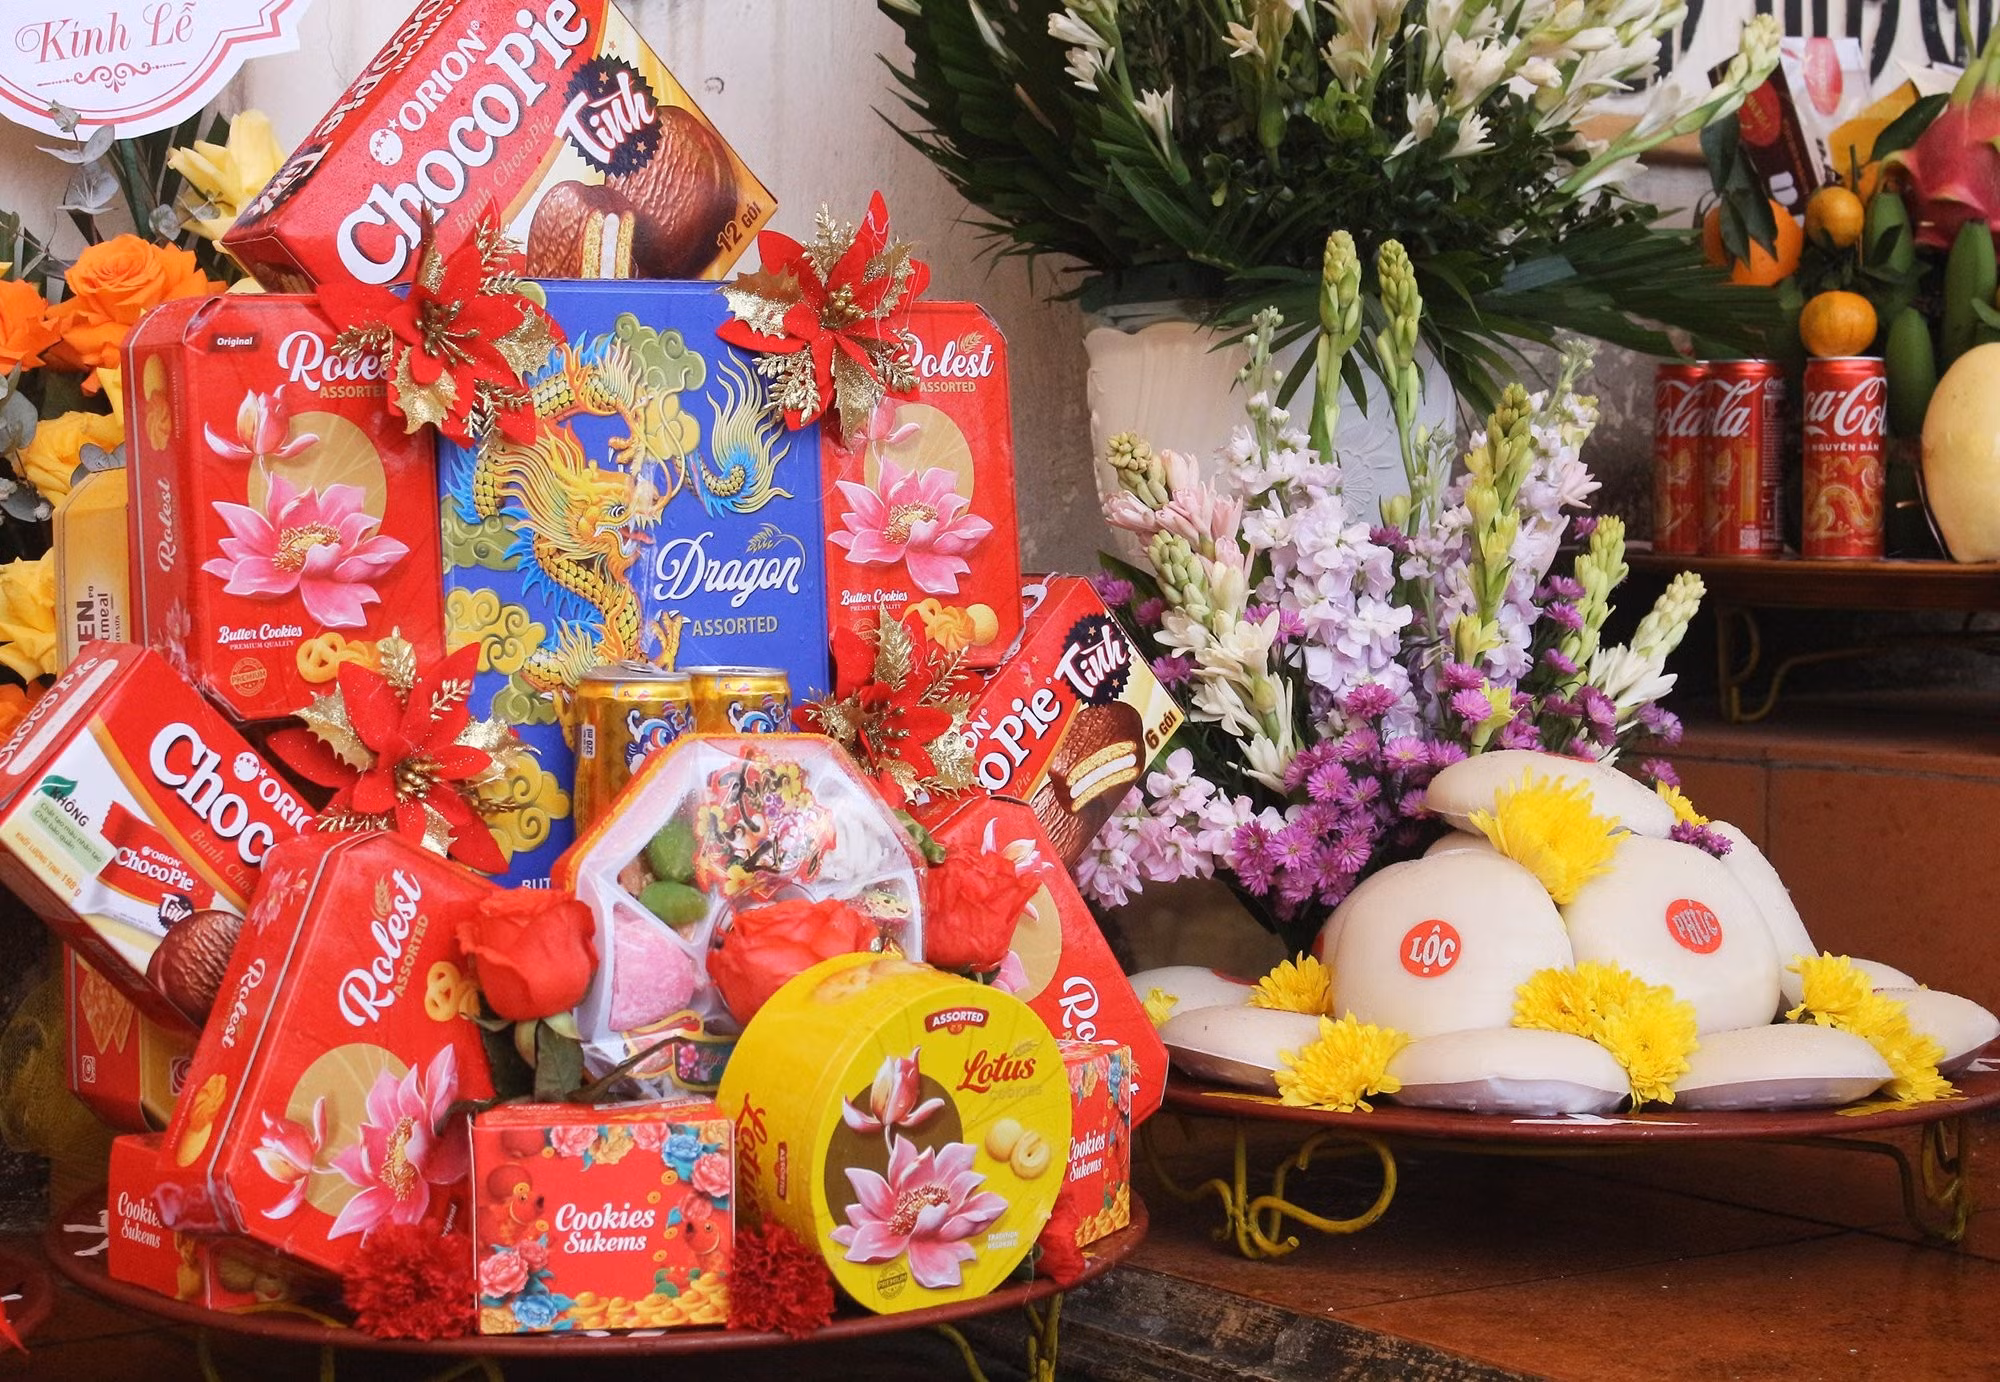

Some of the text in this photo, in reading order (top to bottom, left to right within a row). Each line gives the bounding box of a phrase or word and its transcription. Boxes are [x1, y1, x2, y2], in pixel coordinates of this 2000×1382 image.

[15, 2, 197, 64] Kính Lễ
[399, 29, 488, 132] ORION
[717, 220, 744, 252] 12
[216, 336, 253, 348] Original
[919, 381, 977, 393] ASSORTED
[157, 477, 177, 572] Rolest
[653, 531, 801, 608] Dragon
[840, 588, 908, 606] Butter Cookies
[217, 623, 303, 644] Butter Cookies
[691, 615, 778, 637] ASSORTED
[1145, 728, 1159, 750] 6
[49, 786, 90, 828] KHÔNG
[149, 722, 279, 872] Choc
[151, 850, 181, 867] ORION
[338, 867, 422, 1027] Rolest
[393, 913, 429, 997] ASSORTED
[1408, 924, 1457, 974] LỘC
[222, 958, 266, 1048] Rolest
[931, 1010, 985, 1027] ASSORTED
[955, 1049, 1036, 1094] Lotus
[1067, 1129, 1106, 1163] Cookies
[1069, 1156, 1103, 1184] Sukems
[555, 1202, 656, 1232] Cookies
[121, 1218, 161, 1249] Sukems
[563, 1230, 648, 1254] Sukems
